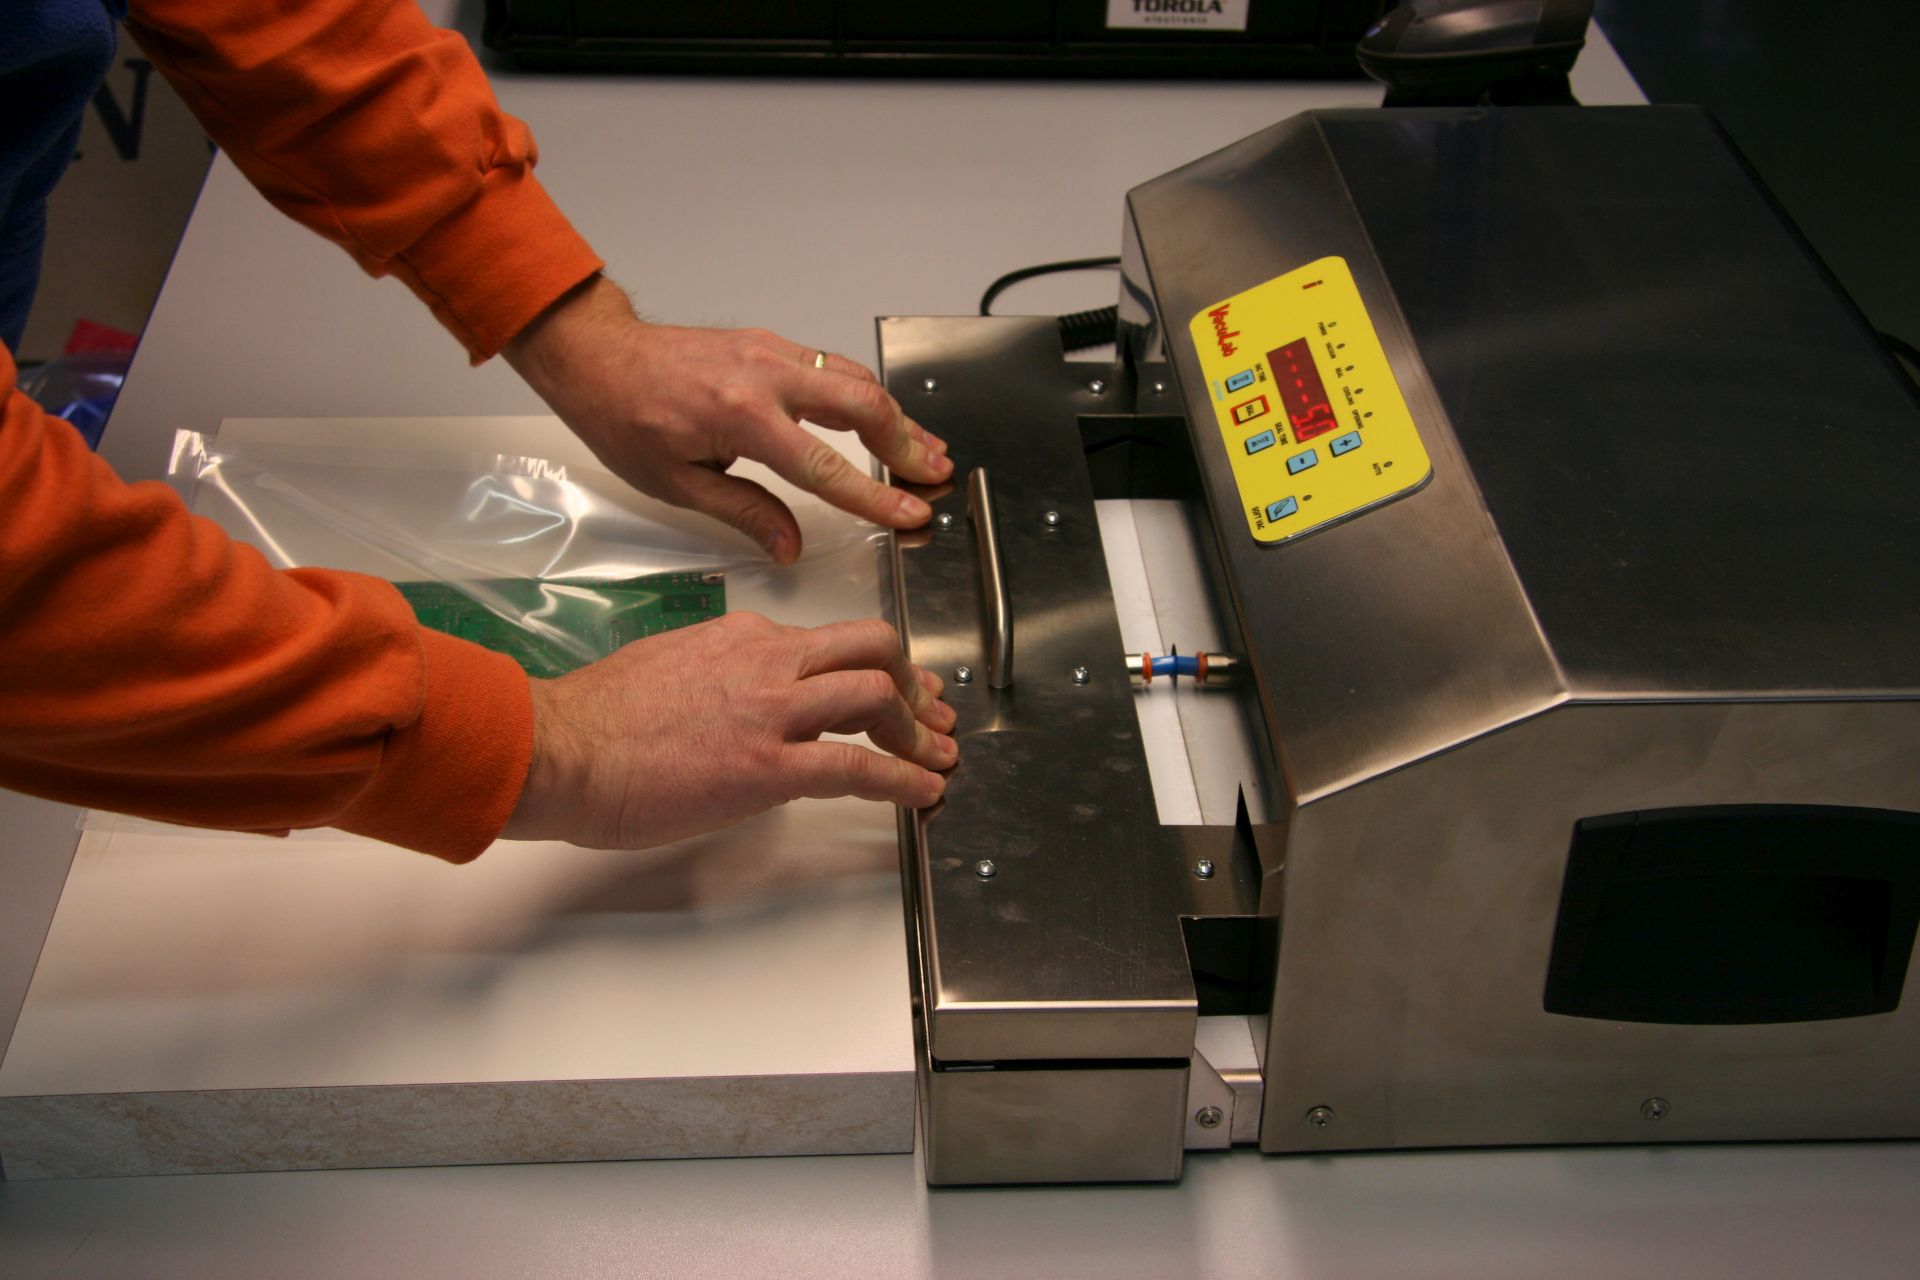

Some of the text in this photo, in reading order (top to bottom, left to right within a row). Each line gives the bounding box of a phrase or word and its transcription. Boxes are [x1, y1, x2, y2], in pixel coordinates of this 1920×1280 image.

[1326, 342, 1336, 359] VACUUM
[1343, 386, 1354, 405] COOLING
[1352, 409, 1363, 429] OPENING
